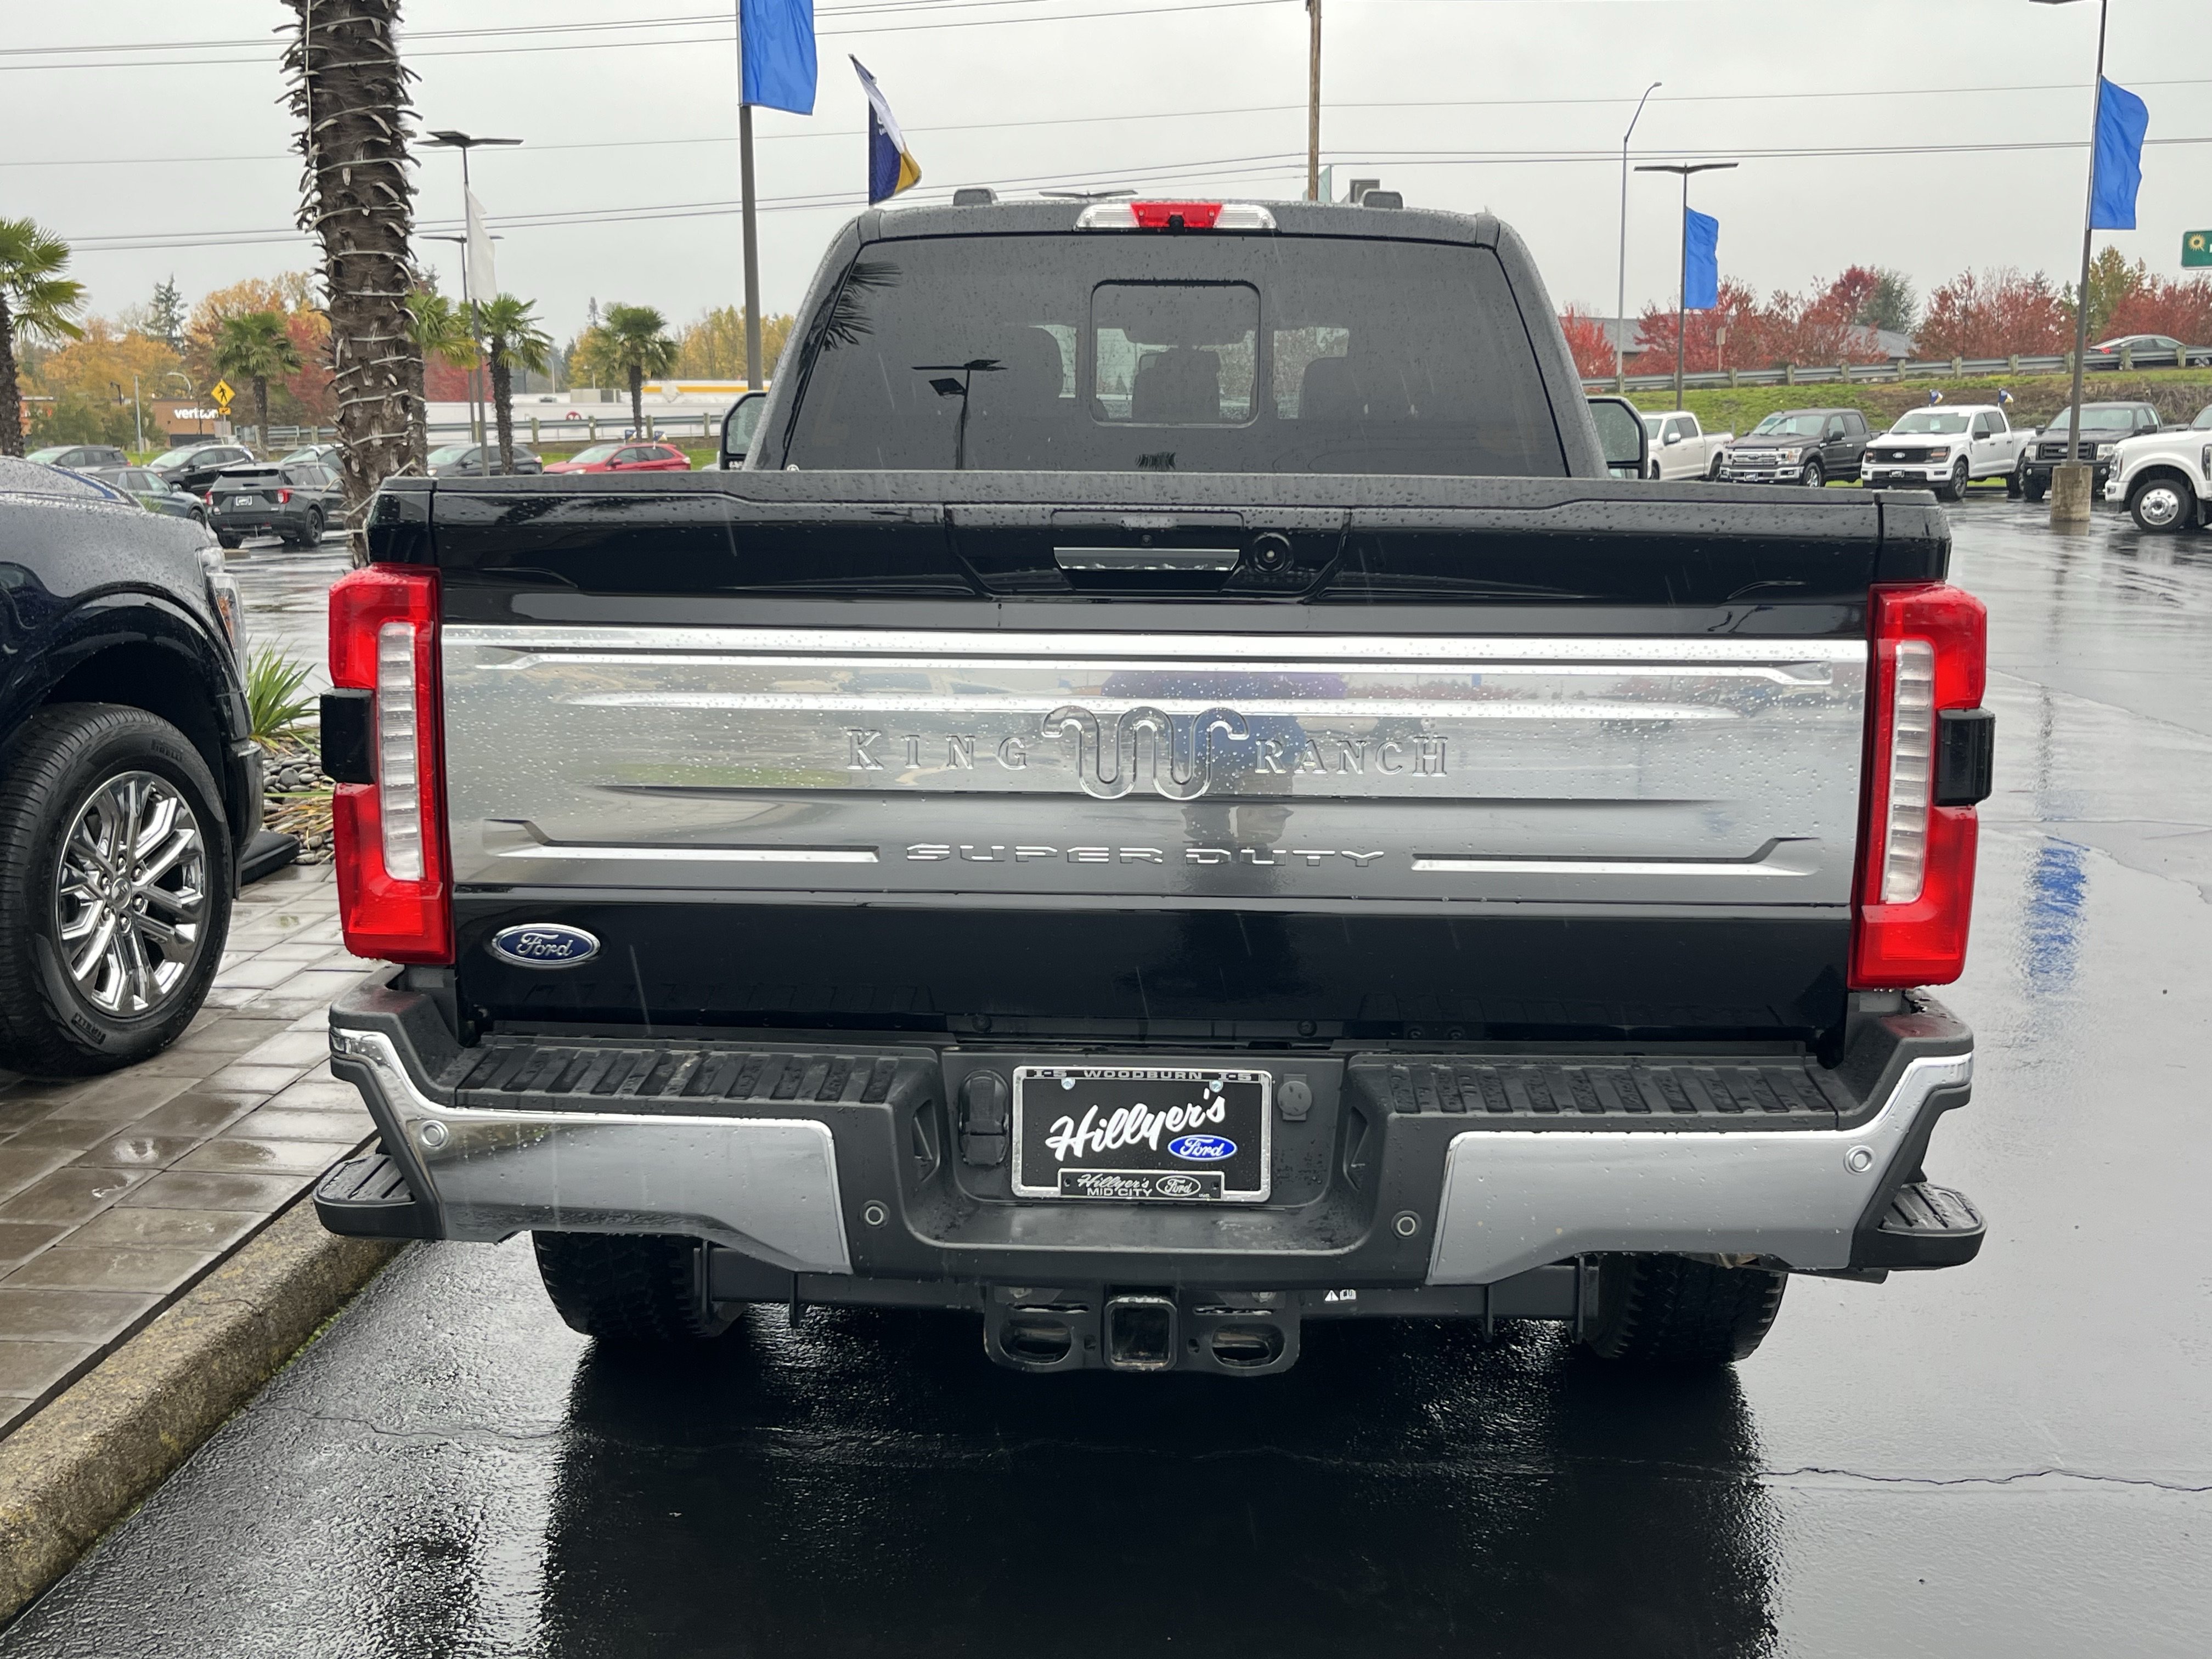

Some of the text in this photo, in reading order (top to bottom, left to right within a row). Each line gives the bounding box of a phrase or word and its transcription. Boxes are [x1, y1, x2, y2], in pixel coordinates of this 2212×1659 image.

[847, 729, 1448, 777] KING RANCH
[906, 844, 1385, 868] SUPER DUTY
[516, 933, 573, 956] Ford
[1084, 1070, 1203, 1080] WOODBURN
[1218, 1073, 1252, 1081] I-5
[1045, 1088, 1226, 1161] Hillyer's
[1180, 1137, 1224, 1157] Ford
[1077, 1173, 1150, 1192] Hillyer's
[1087, 1188, 1153, 1197] MID CITY
[1164, 1178, 1193, 1193] Ford
